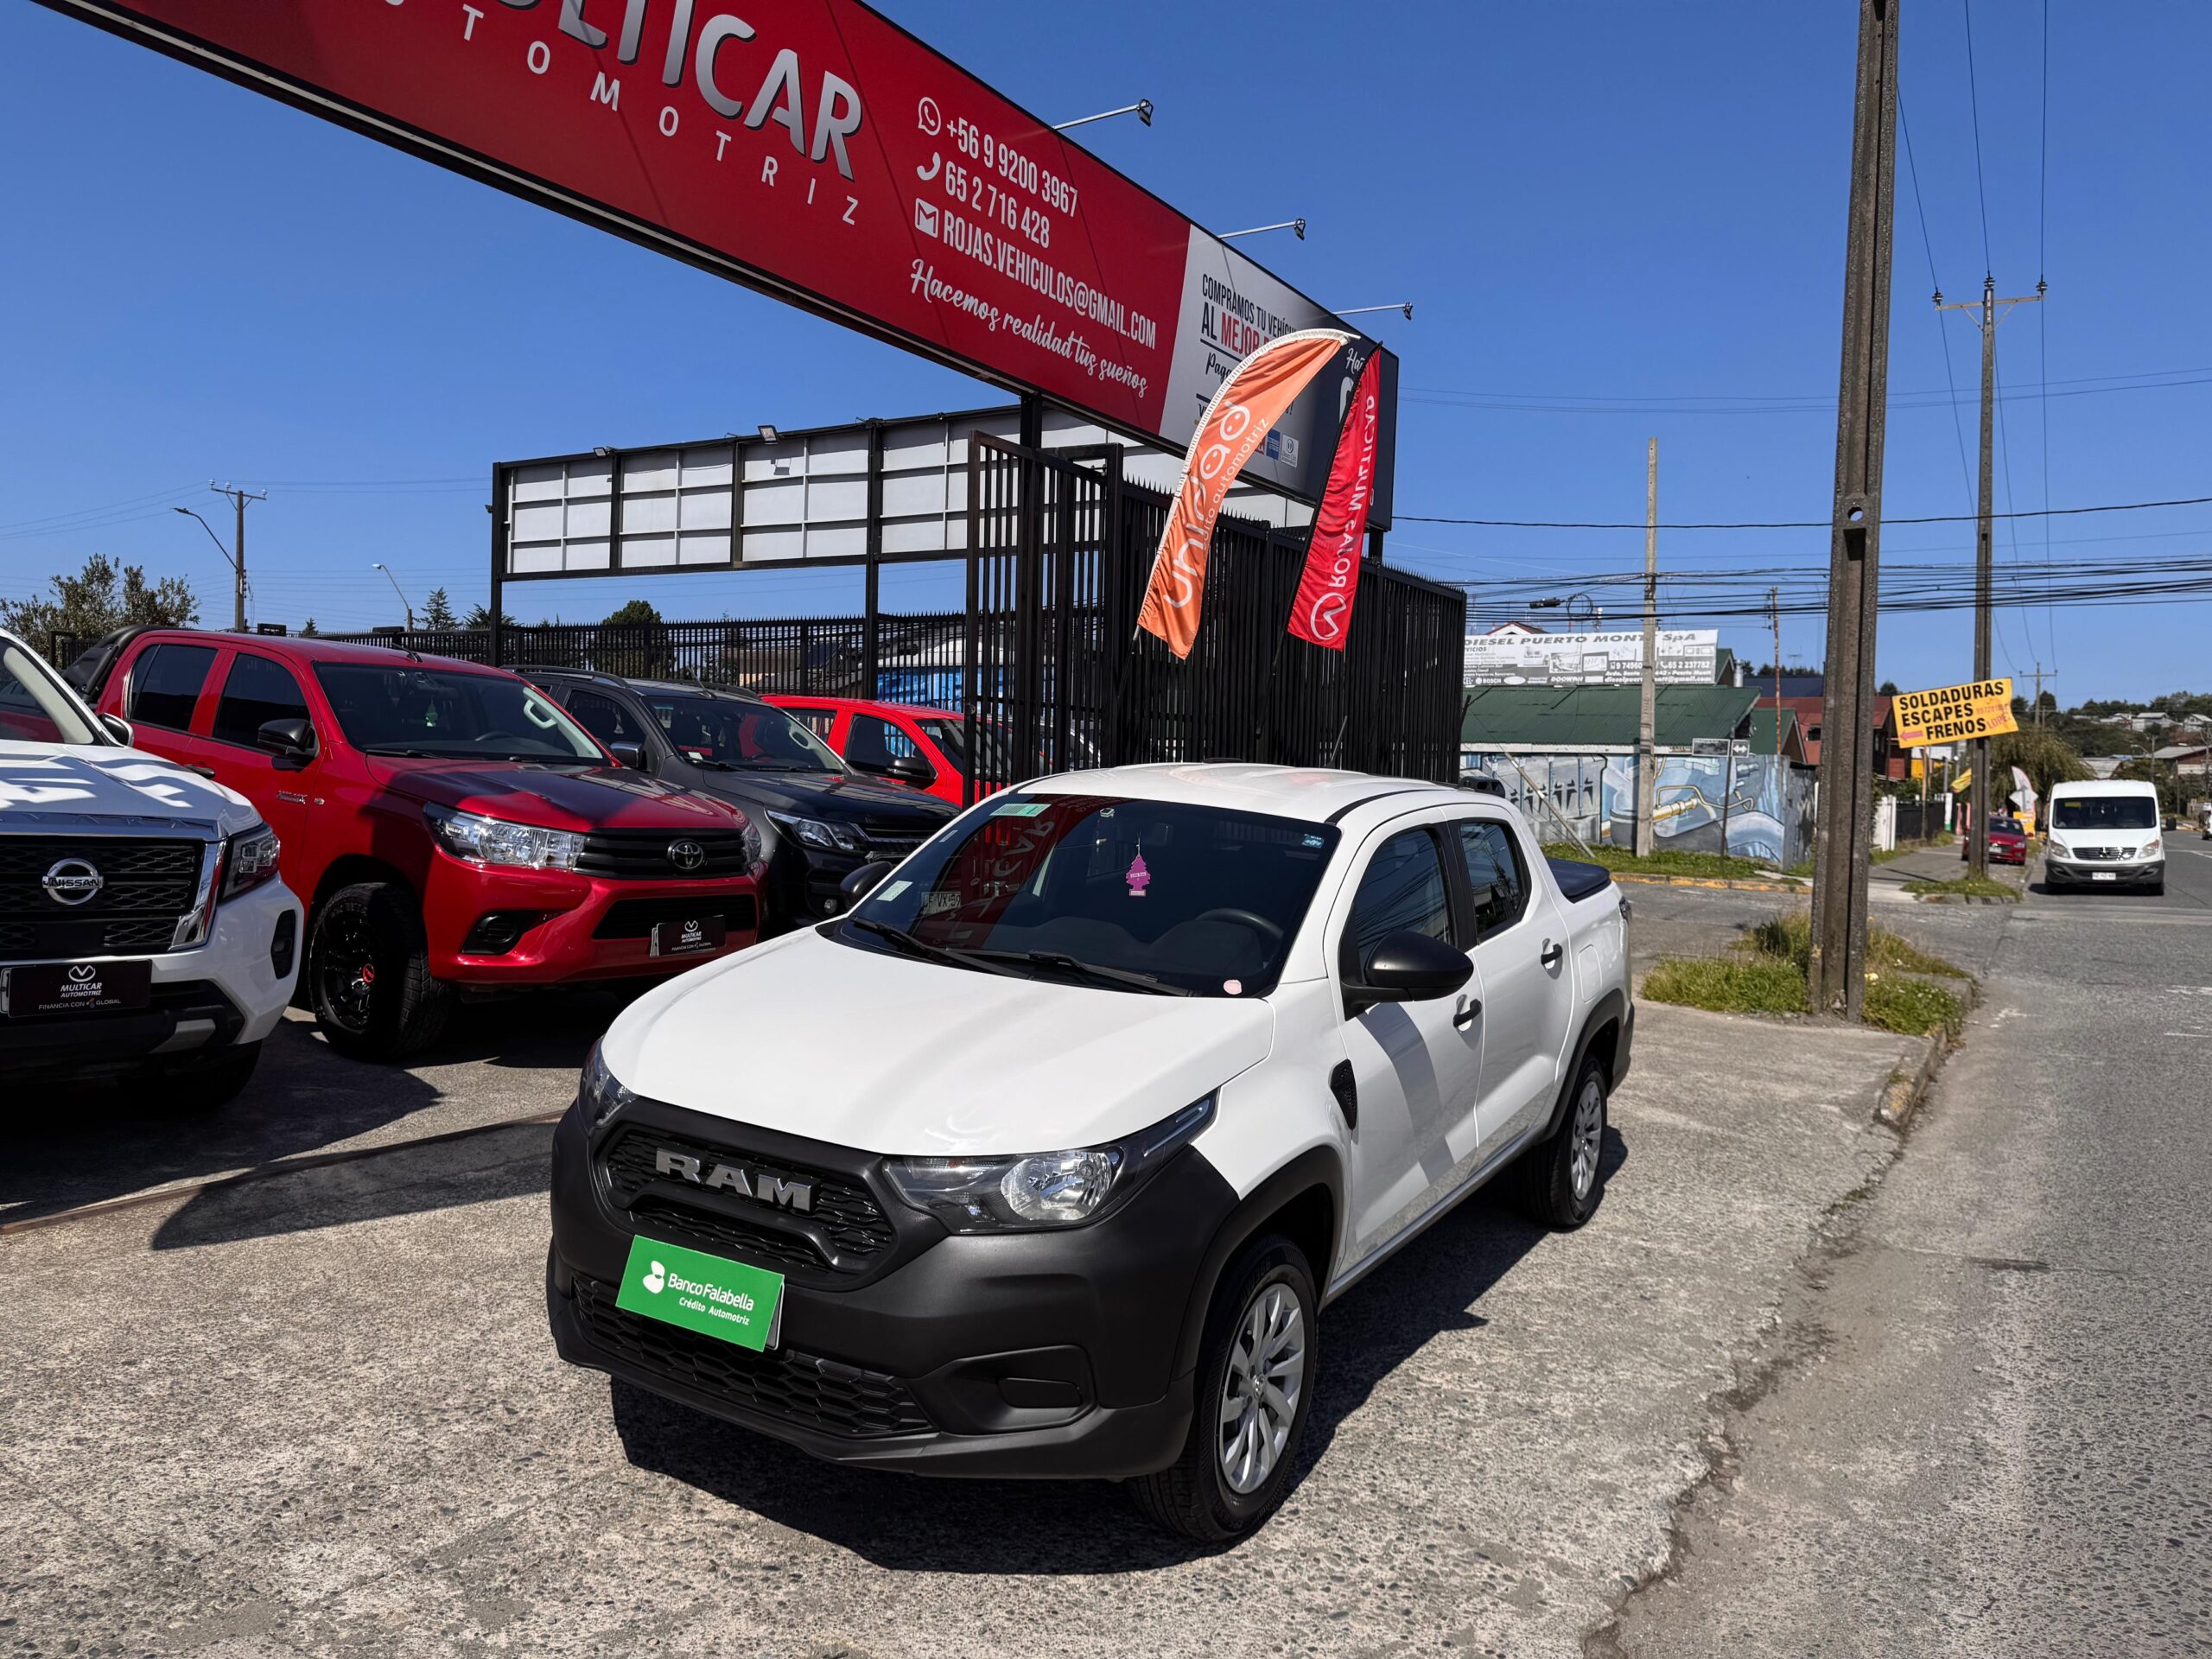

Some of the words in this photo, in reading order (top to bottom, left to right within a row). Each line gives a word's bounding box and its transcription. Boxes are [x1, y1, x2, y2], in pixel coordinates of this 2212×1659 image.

[385, 0, 859, 225] TOMOTRIZ
[946, 118, 979, 159] +56
[983, 134, 994, 168] 9
[998, 143, 1038, 194] 9200
[1041, 170, 1078, 218] 3967
[945, 161, 967, 202] 65
[971, 174, 982, 211] 2
[988, 184, 1017, 231] 716
[1020, 207, 1050, 248] 428
[944, 209, 1156, 350] ROJAS.VEHICULOS@GMAIL.COM
[1202, 273, 1255, 325] COMPRAMOS
[1256, 306, 1266, 331] TU
[1268, 312, 1296, 339] VEHÍC
[911, 258, 1001, 332] Hacemos
[1001, 315, 1073, 359] realidad
[1069, 328, 1097, 376] tus
[1099, 357, 1148, 398] sueños
[1201, 302, 1217, 340] AL
[1221, 311, 1260, 358] MEJOR
[1212, 418, 1270, 505] automotriz
[1521, 636, 1587, 645] PUERTO
[1593, 634, 1645, 643] MONT
[1662, 633, 1696, 643] SpA
[1678, 660, 1683, 669] 2
[1900, 682, 2004, 711] SOLDADURAS
[1902, 702, 1974, 728] ESCAPES
[1926, 718, 1986, 741] FRENOS
[49, 879, 100, 888] NISSAN
[60, 982, 103, 993] MULTICAR
[60, 989, 102, 998] AUTOMOTRIZ
[656, 1147, 814, 1211] RAM
[678, 1296, 706, 1313] Crédito
[708, 1306, 750, 1326] Automotriz
